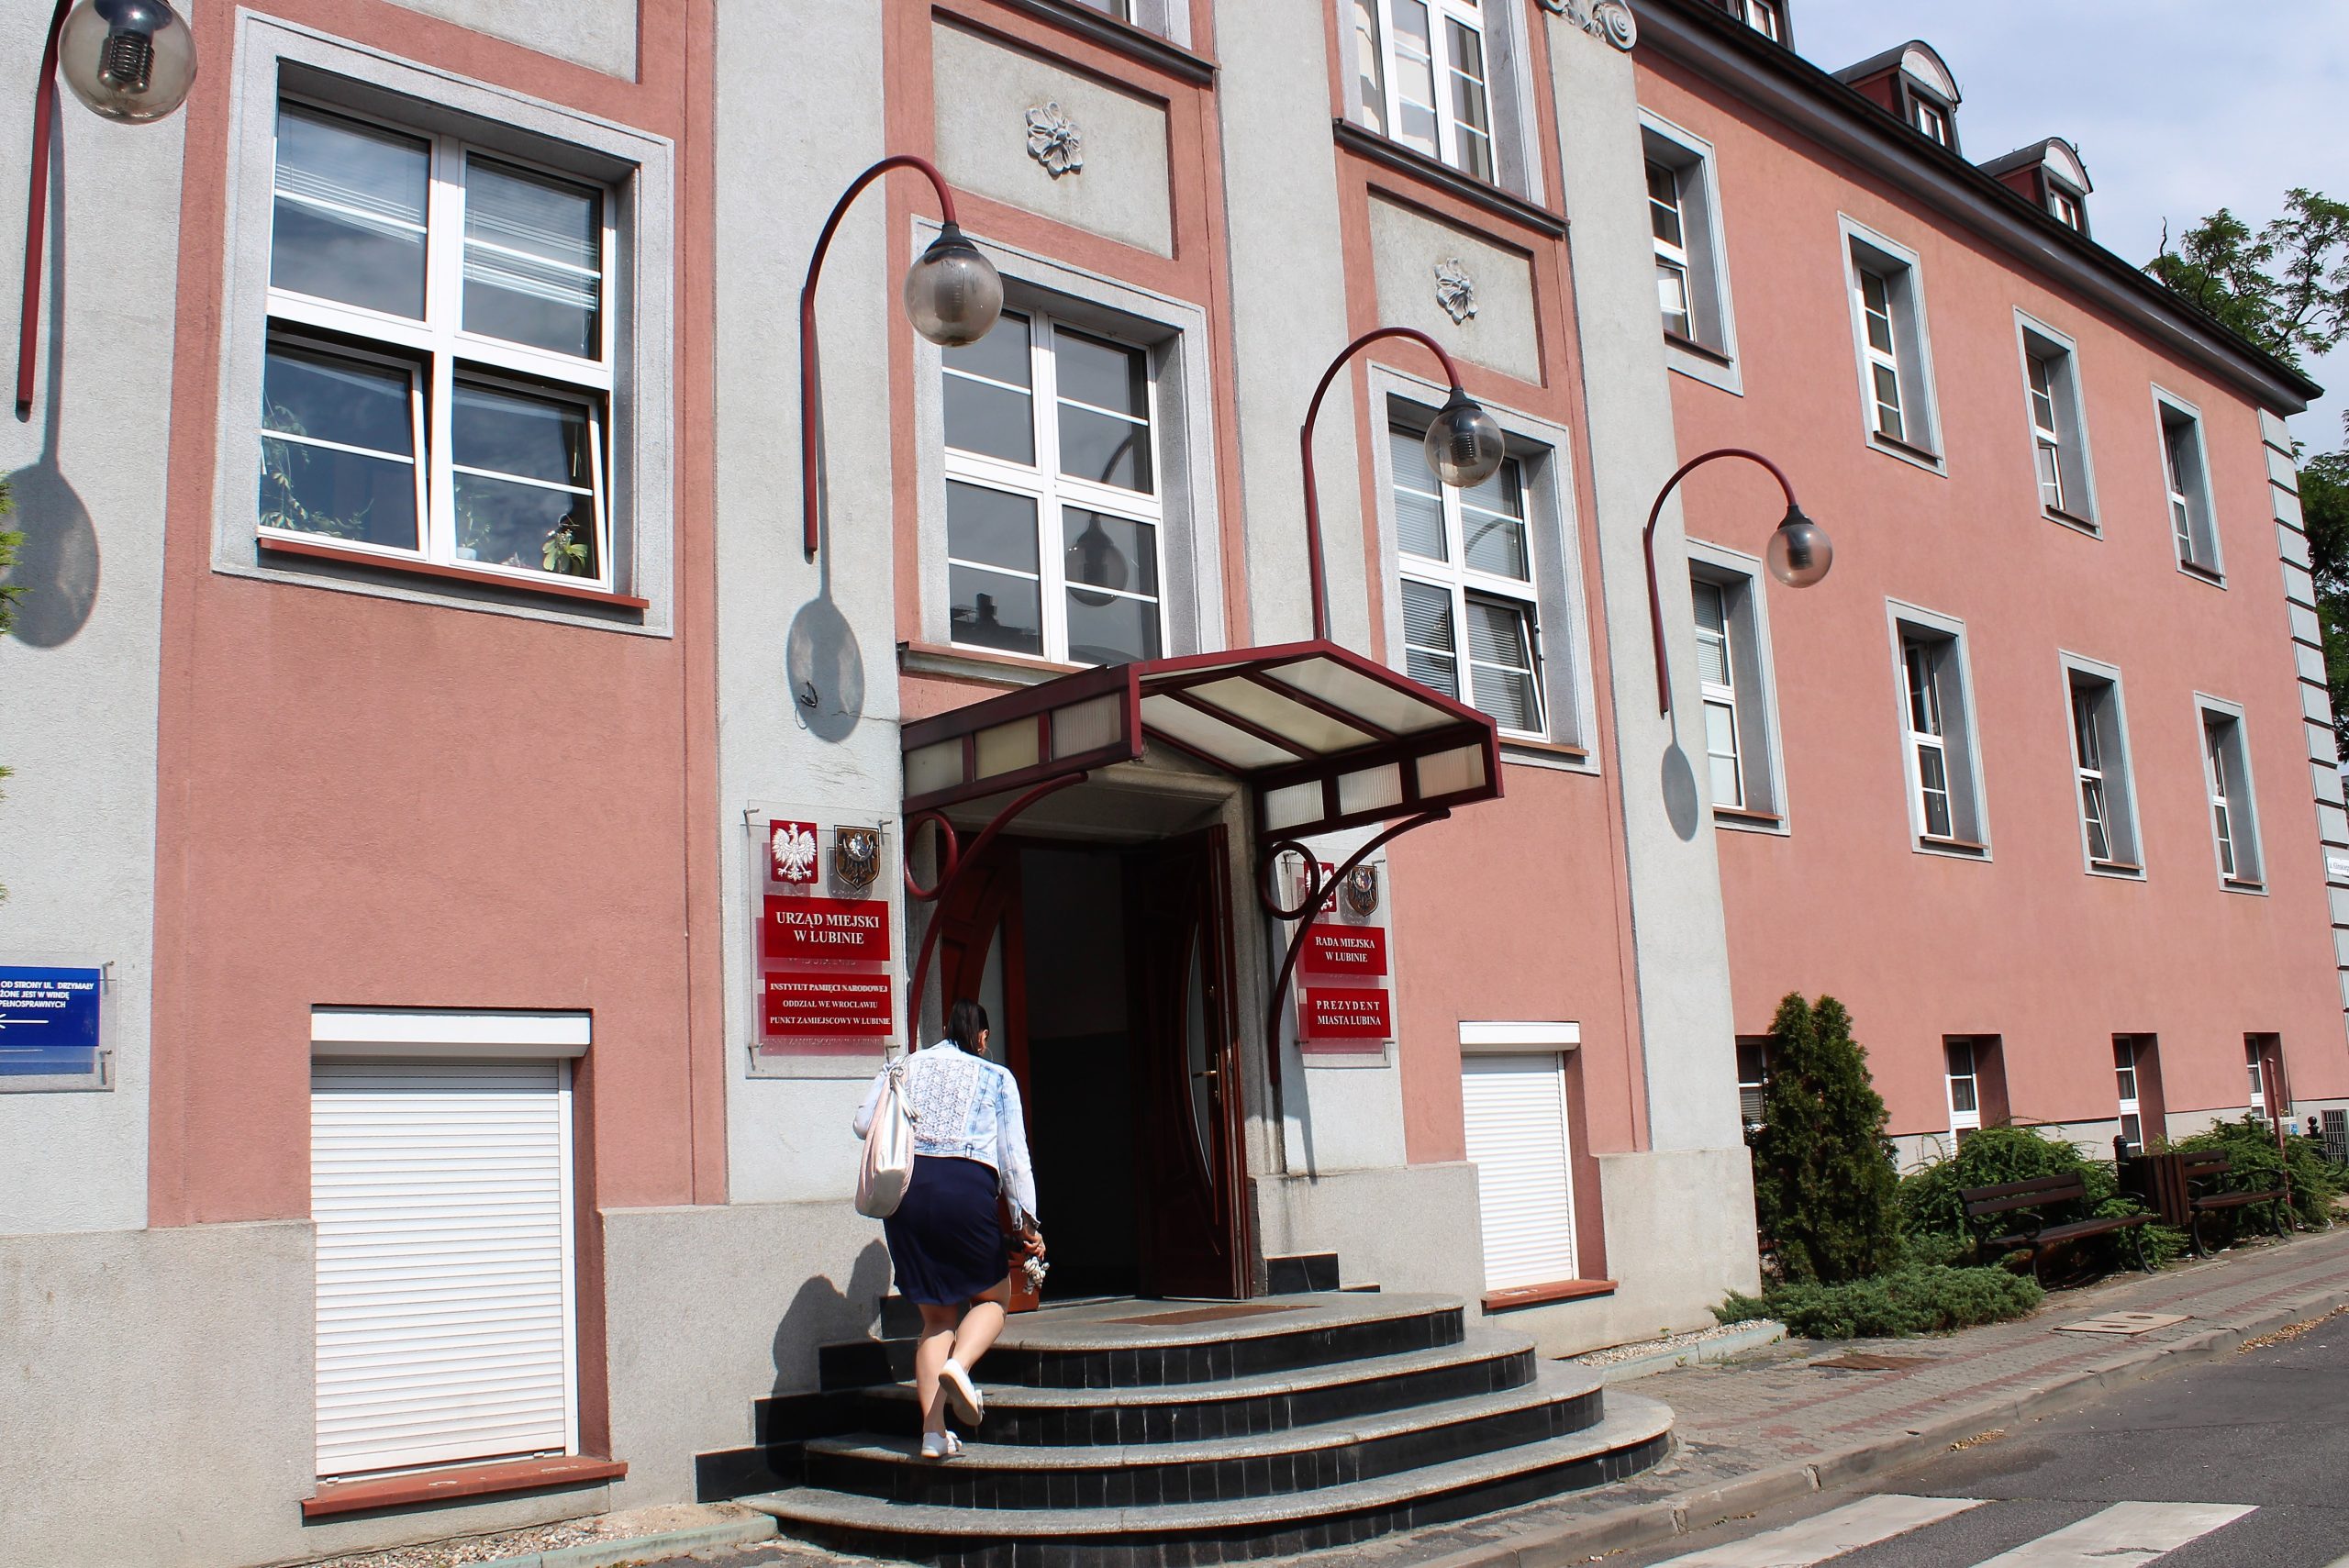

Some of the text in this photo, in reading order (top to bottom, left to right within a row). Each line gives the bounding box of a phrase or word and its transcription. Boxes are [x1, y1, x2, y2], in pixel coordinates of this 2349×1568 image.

[776, 912, 879, 929] URZĄD MIEJSKI
[794, 930, 864, 944] W LUBINIE
[1315, 937, 1375, 949] RADA MIEJSKA
[1325, 951, 1367, 962] W LUBINIE
[770, 983, 887, 993] INSTYTUT PAMIĘCI NARODOWEJ
[46, 991, 70, 1000] WINDĘ
[1316, 1000, 1380, 1011] PREZYDENT
[796, 1017, 852, 1025] ZAMIEJSCOWY
[1317, 1015, 1381, 1026] MIASTA LUBINA
